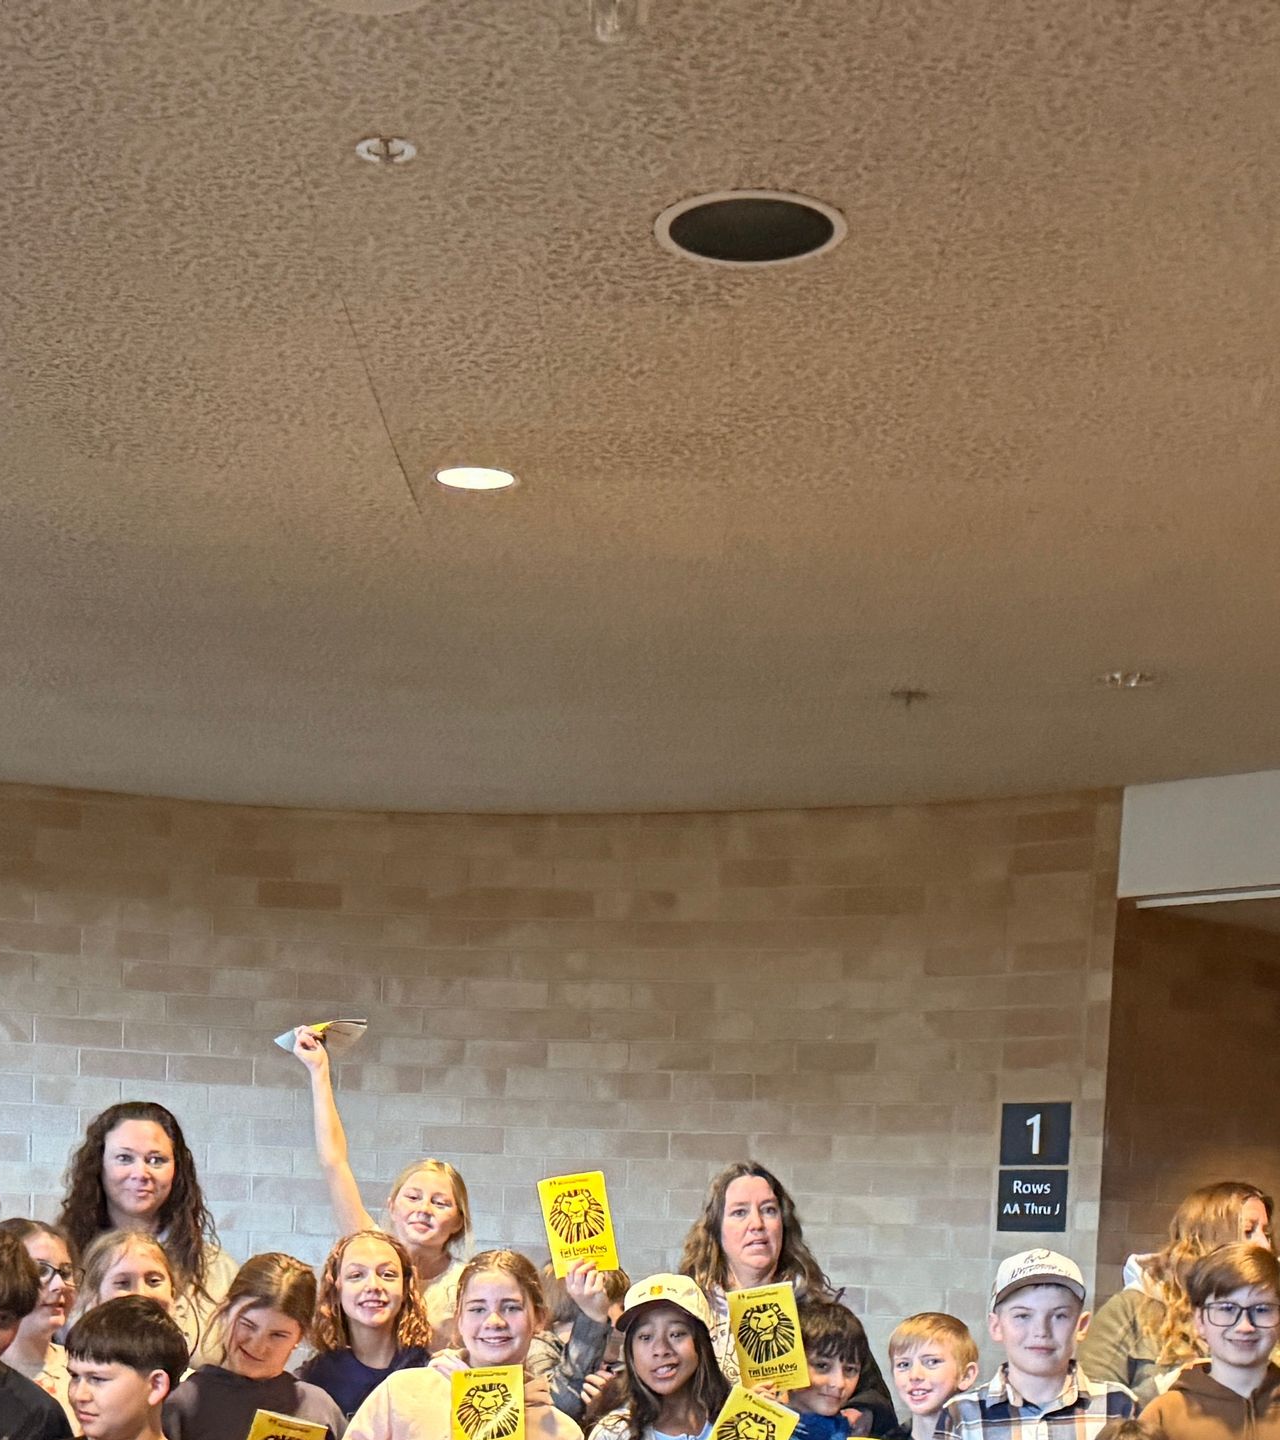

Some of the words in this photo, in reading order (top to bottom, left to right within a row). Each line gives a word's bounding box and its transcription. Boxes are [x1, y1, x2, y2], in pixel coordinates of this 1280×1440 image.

[1026, 1113, 1042, 1155] 1
[1013, 1180, 1051, 1195] Rows
[1003, 1204, 1020, 1215] AA
[1025, 1203, 1051, 1216] Thru
